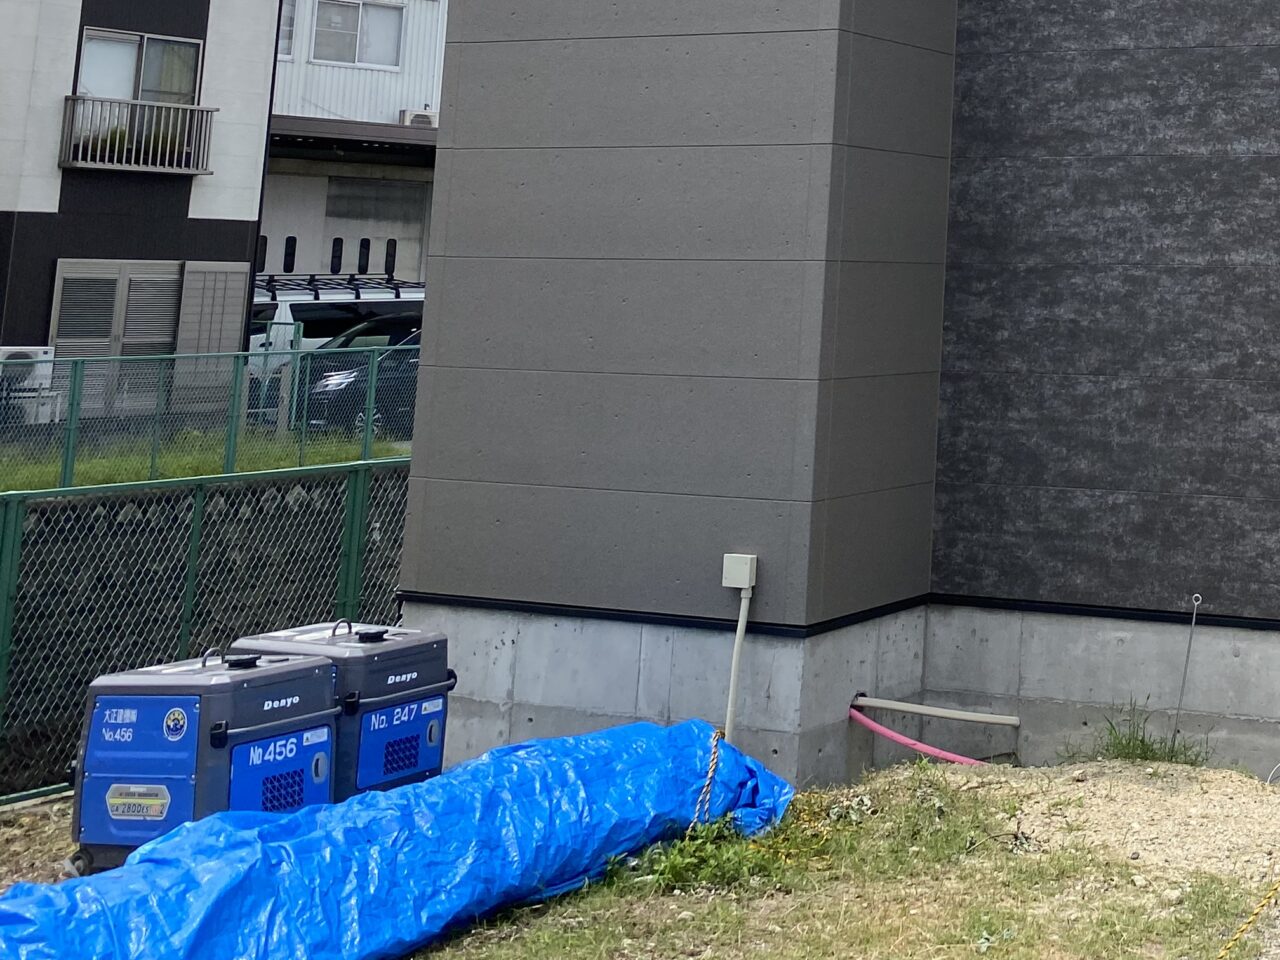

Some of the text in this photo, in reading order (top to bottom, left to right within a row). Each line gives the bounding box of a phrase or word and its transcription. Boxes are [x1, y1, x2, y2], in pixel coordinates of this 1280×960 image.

[387, 672, 418, 684] Denyo
[263, 696, 300, 711] Denyo
[393, 704, 418, 725] 247
